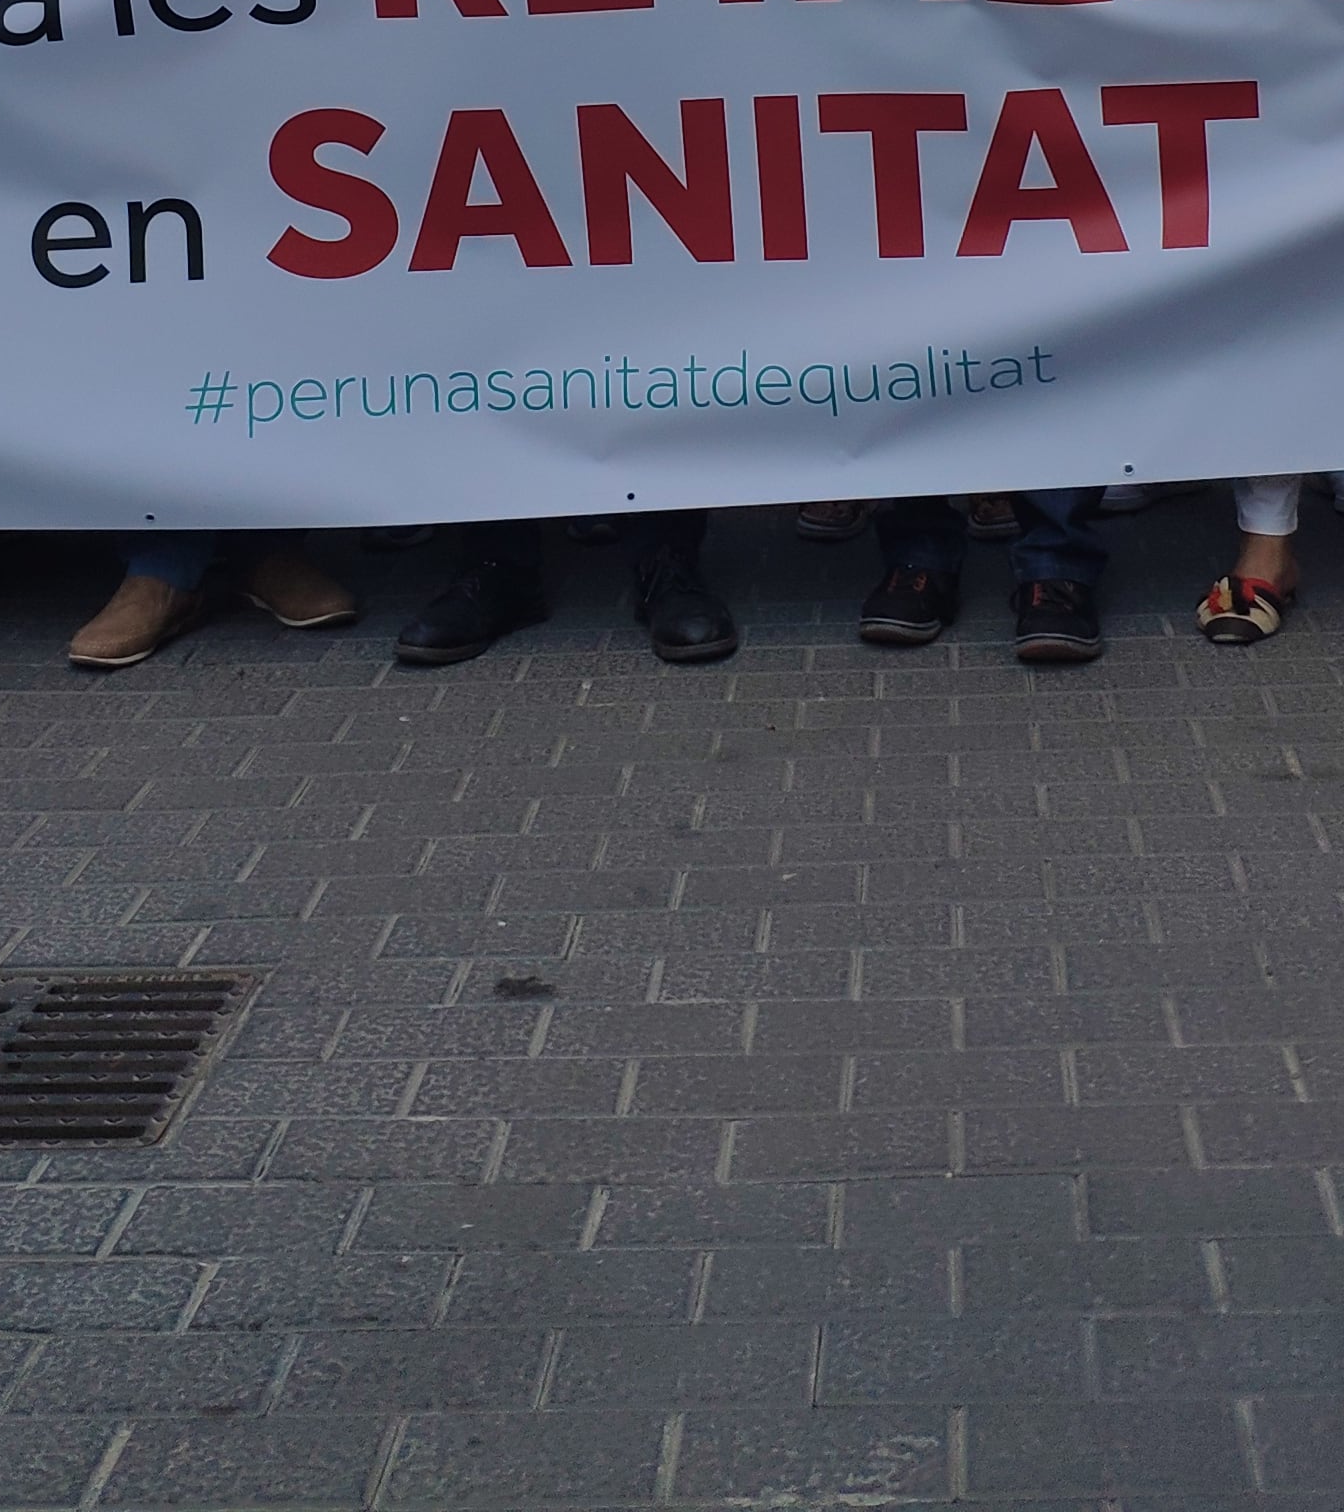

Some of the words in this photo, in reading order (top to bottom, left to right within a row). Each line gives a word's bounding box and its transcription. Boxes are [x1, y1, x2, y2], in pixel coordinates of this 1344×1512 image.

[31, 196, 205, 289] en
[267, 80, 1260, 279] SANITAT
[185, 342, 1057, 437] #perunasanitatdequalitat
